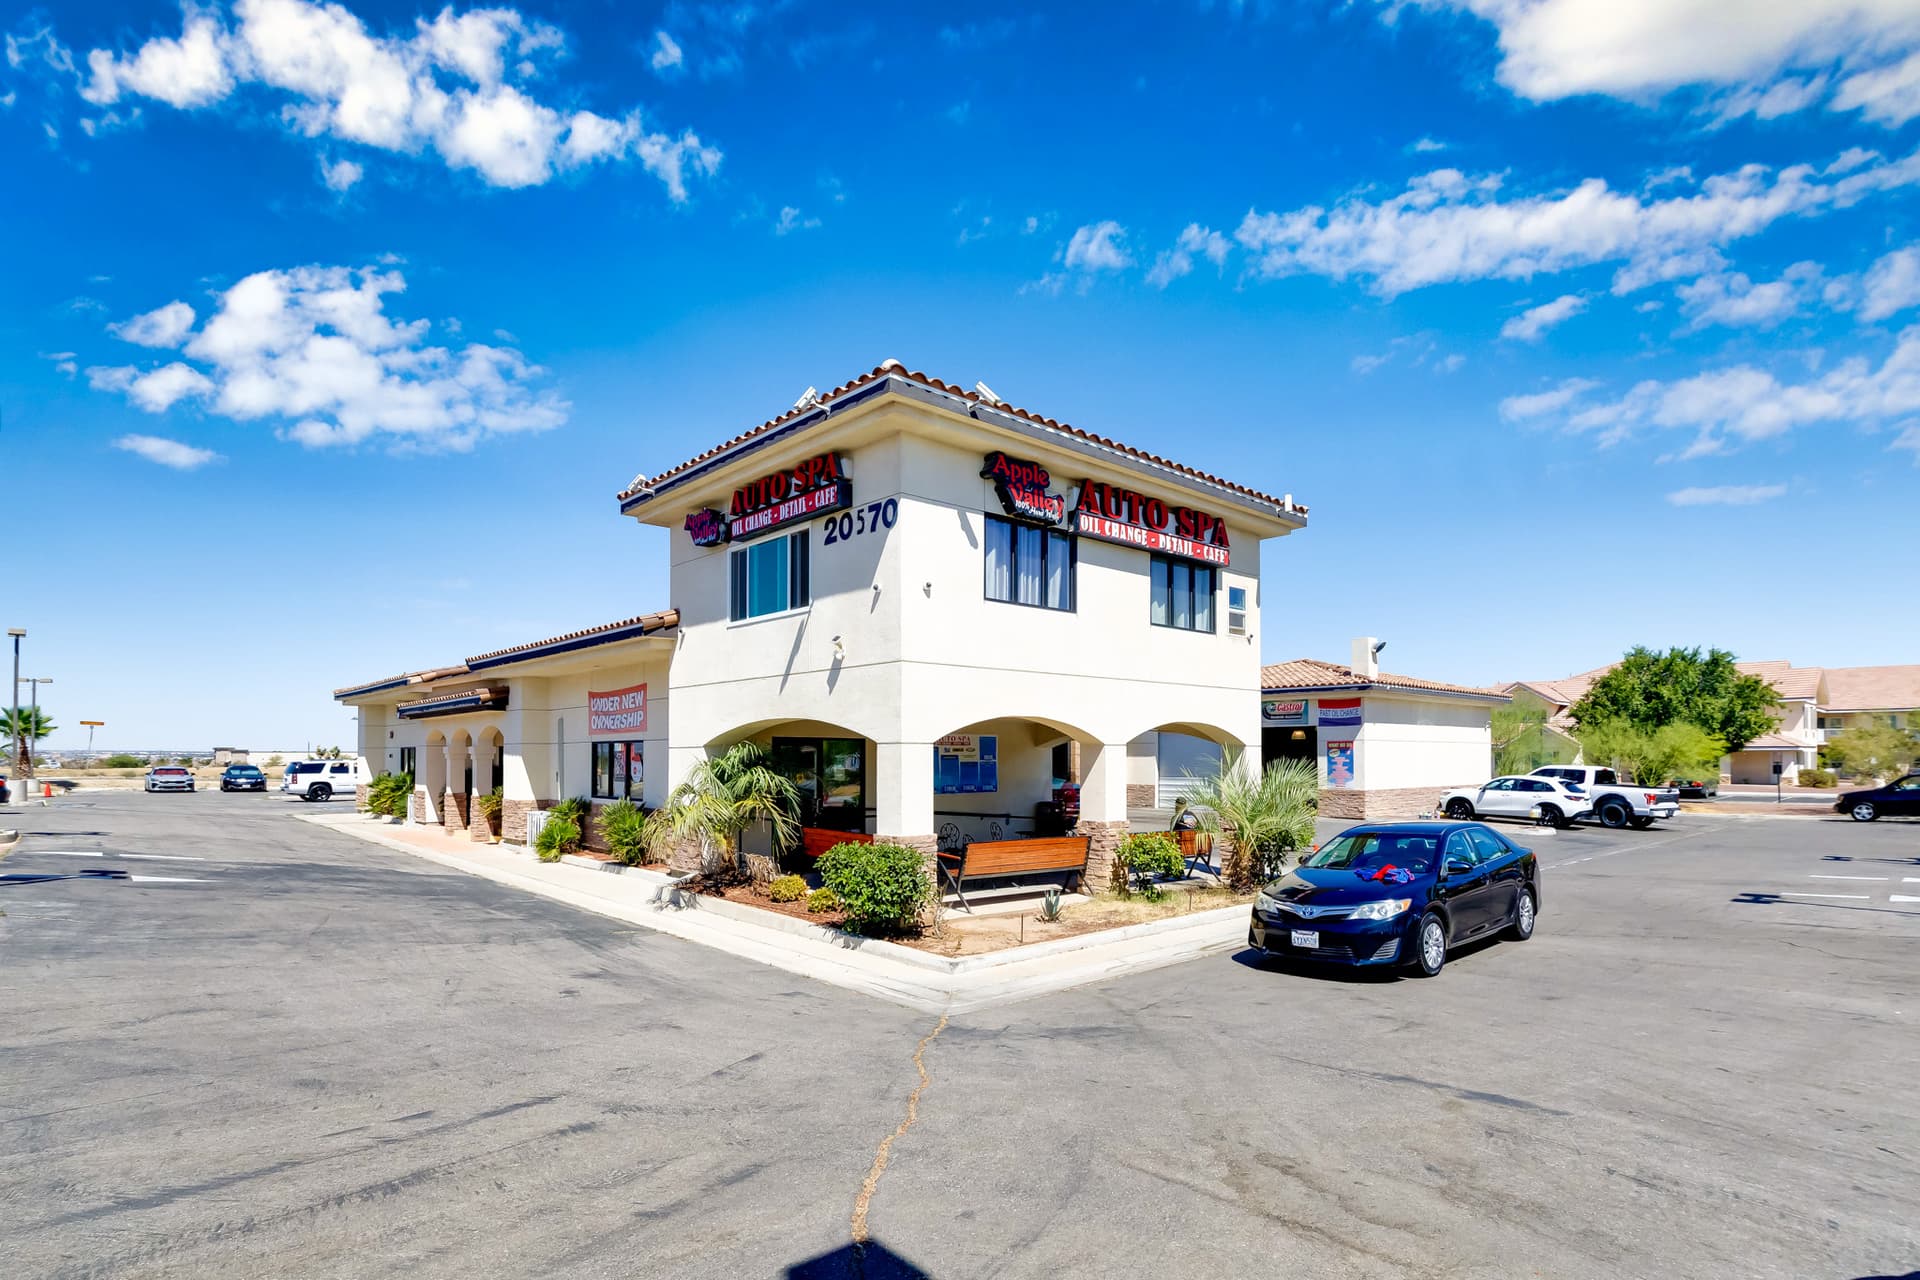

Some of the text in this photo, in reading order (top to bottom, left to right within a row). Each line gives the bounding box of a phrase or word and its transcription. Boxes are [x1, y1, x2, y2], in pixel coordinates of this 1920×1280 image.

[729, 452, 838, 516] AUTO SPA
[992, 454, 1049, 486] Apple
[732, 519, 744, 537] OIL
[745, 509, 773, 532] CHANGE
[779, 497, 807, 520] DETAIL
[1008, 483, 1064, 518] Valley
[1078, 479, 1230, 548] AUTO SPA
[823, 498, 898, 546] 20570
[1080, 515, 1101, 534] OIL
[1104, 521, 1148, 545] CHANGE
[1159, 535, 1194, 556] DETAIL
[591, 690, 644, 712] UNDER NEW
[591, 711, 644, 729] OWNERSHIP
